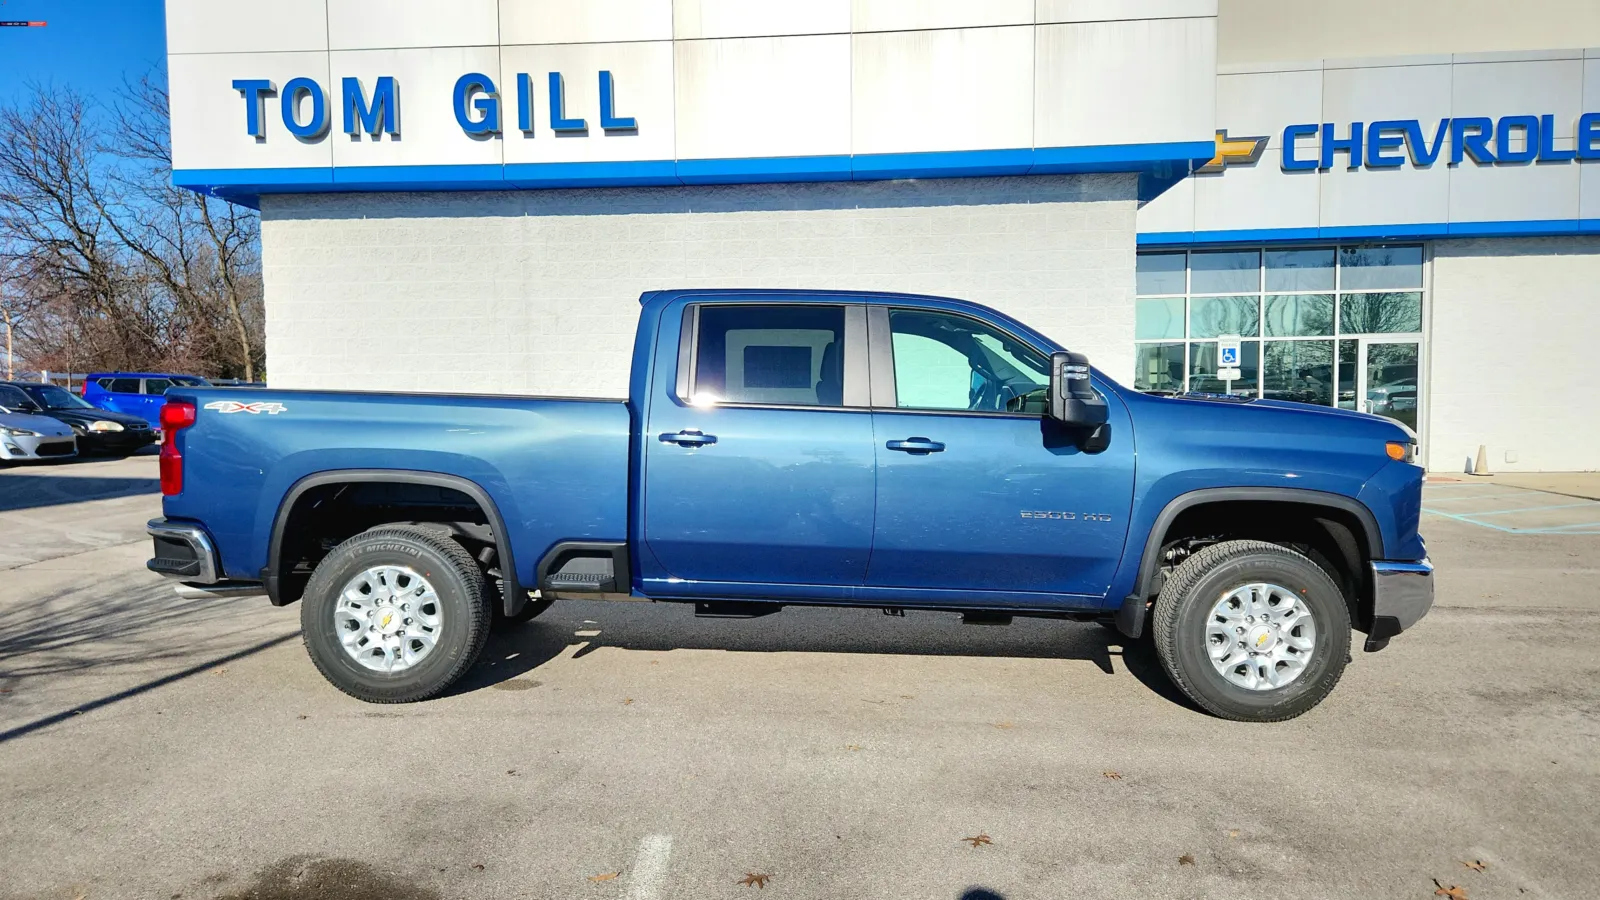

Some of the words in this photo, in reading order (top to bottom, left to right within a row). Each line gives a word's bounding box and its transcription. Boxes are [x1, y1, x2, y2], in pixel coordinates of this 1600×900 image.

[231, 75, 400, 142] TOM
[452, 70, 638, 138] GILL
[1020, 509, 1076, 520] 2500
[1083, 512, 1112, 522] HD
[366, 544, 418, 556] MICHELIN
